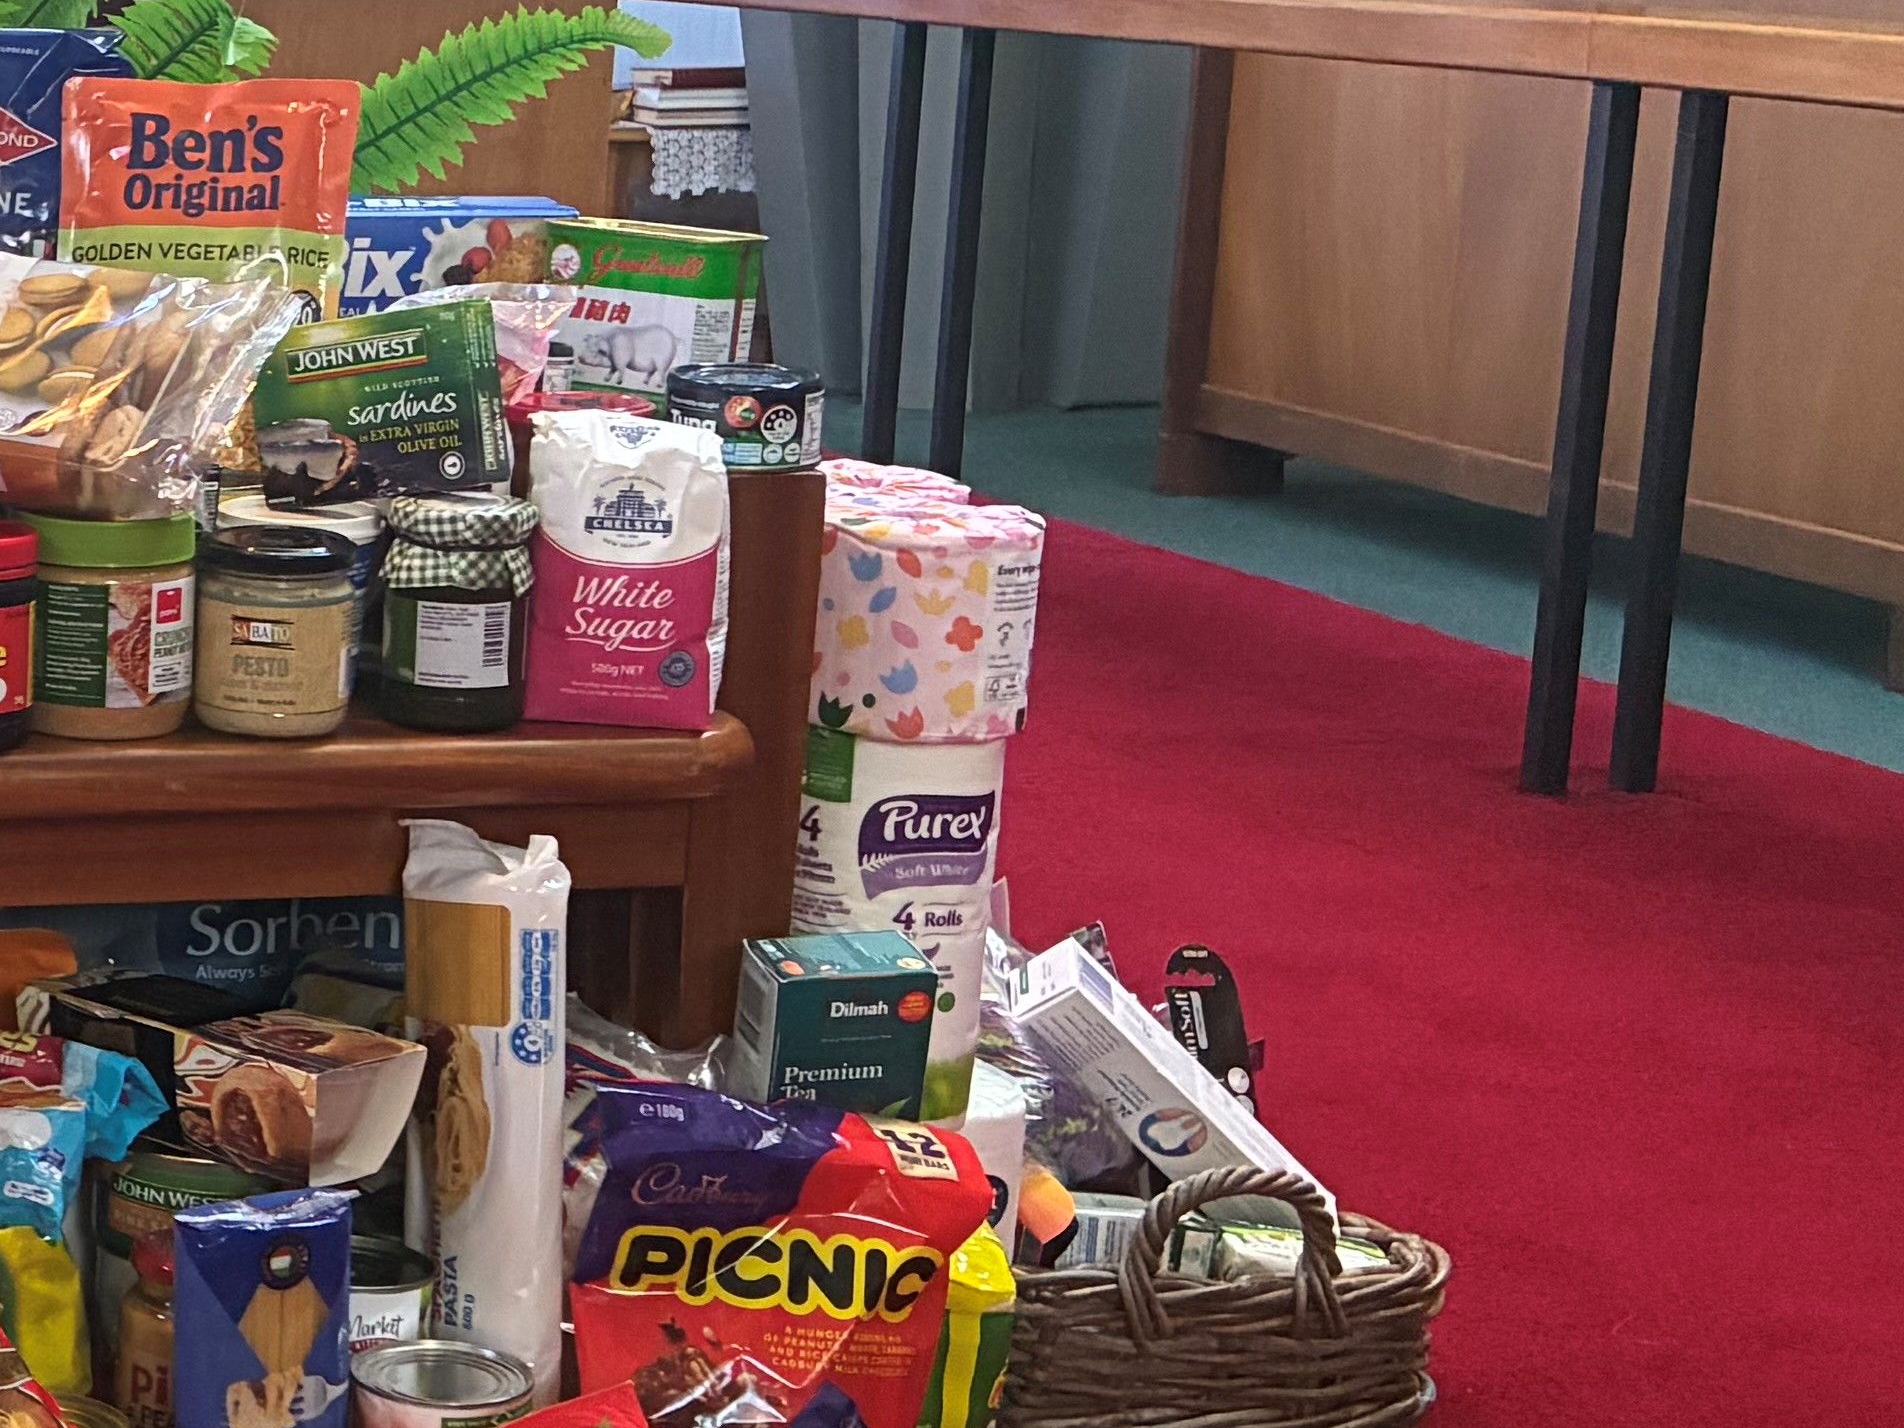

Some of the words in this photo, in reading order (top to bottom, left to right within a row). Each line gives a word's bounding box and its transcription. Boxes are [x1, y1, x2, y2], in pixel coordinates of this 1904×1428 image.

[127, 111, 284, 173] Ben's
[123, 174, 282, 218] Original
[72, 243, 151, 265] GOLDEN
[160, 239, 280, 261] VEGETABLE
[288, 246, 329, 268] RICE
[295, 347, 353, 372] JOHN
[356, 336, 418, 360] WEST
[347, 390, 458, 426] sardines
[369, 427, 412, 443] EXTRA
[415, 418, 460, 436] VIRGIN
[397, 439, 437, 454] OLIVE
[440, 434, 463, 448] OIL
[585, 516, 672, 533] CHELSEA
[572, 575, 675, 610] White
[565, 607, 676, 648] Sugar
[879, 800, 986, 842] Purex
[924, 910, 963, 927] Rolls
[830, 1000, 889, 1019] Dilmah
[783, 1063, 883, 1084] Premium
[879, 1128, 947, 1160] 12
[113, 1175, 166, 1204] JOHN
[444, 1255, 458, 1327] PASTA
[614, 1230, 942, 1320] PICNIC
